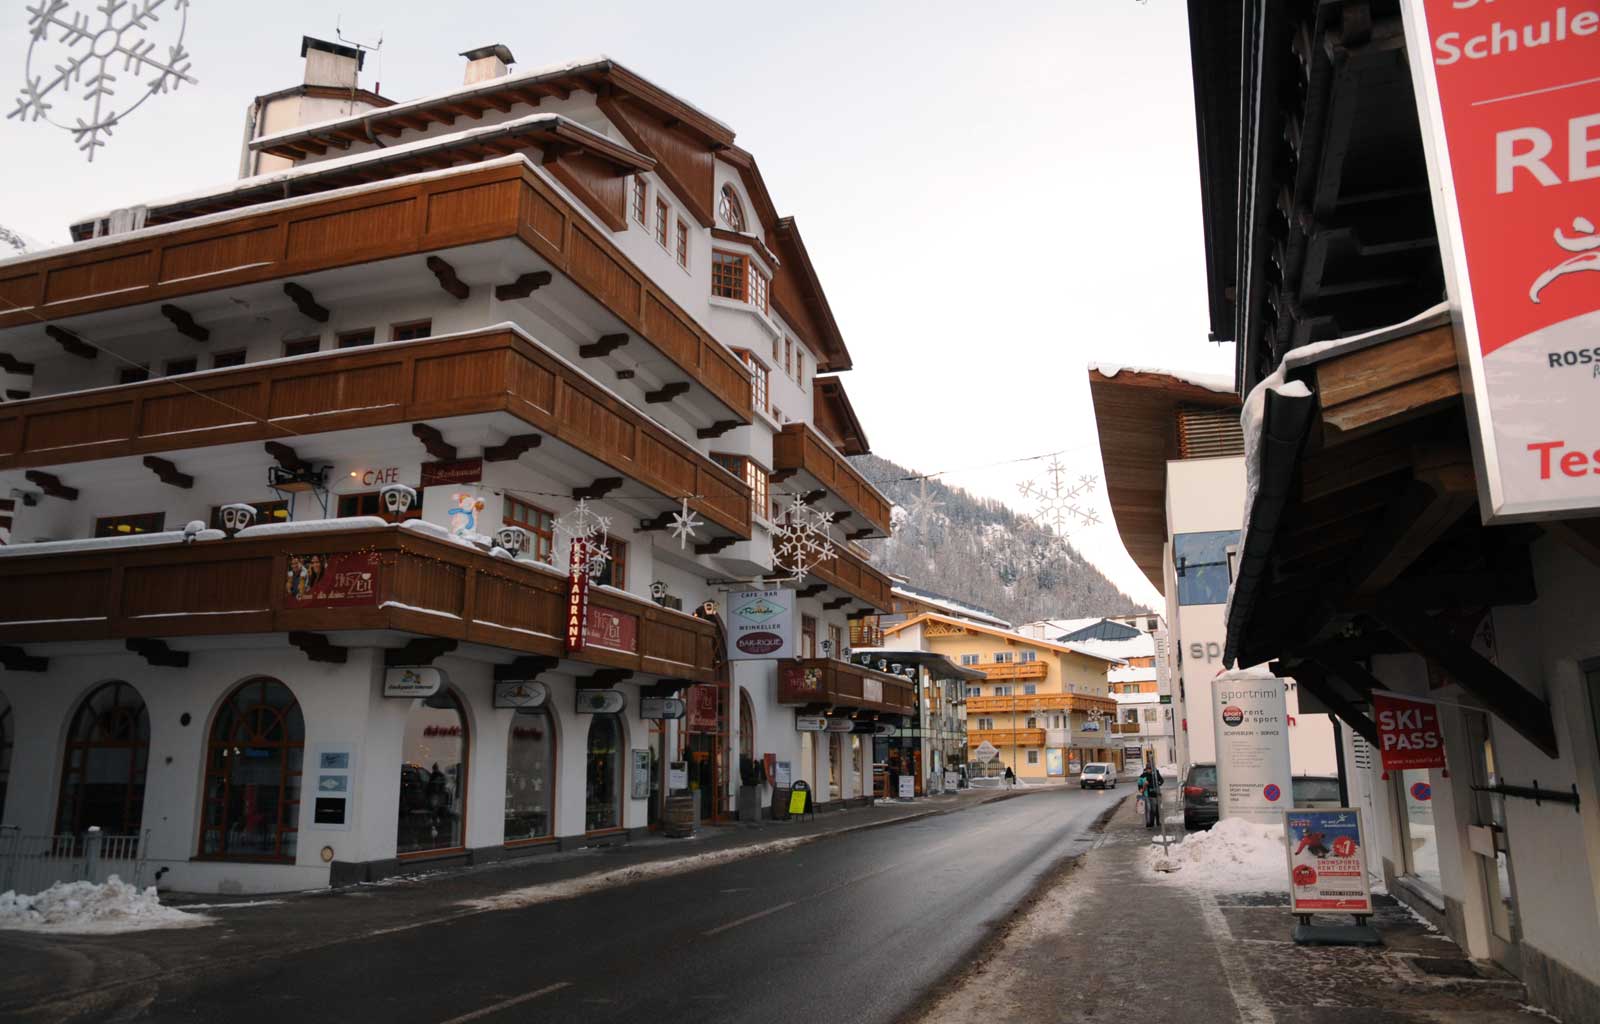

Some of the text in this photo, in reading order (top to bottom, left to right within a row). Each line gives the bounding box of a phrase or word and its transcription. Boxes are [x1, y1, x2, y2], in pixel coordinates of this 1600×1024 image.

[1435, 7, 1599, 66] Schule
[362, 467, 399, 486] CAFE
[1221, 688, 1277, 702] sportriml
[1380, 709, 1434, 731] SKI-
[1383, 731, 1439, 752] PASS
